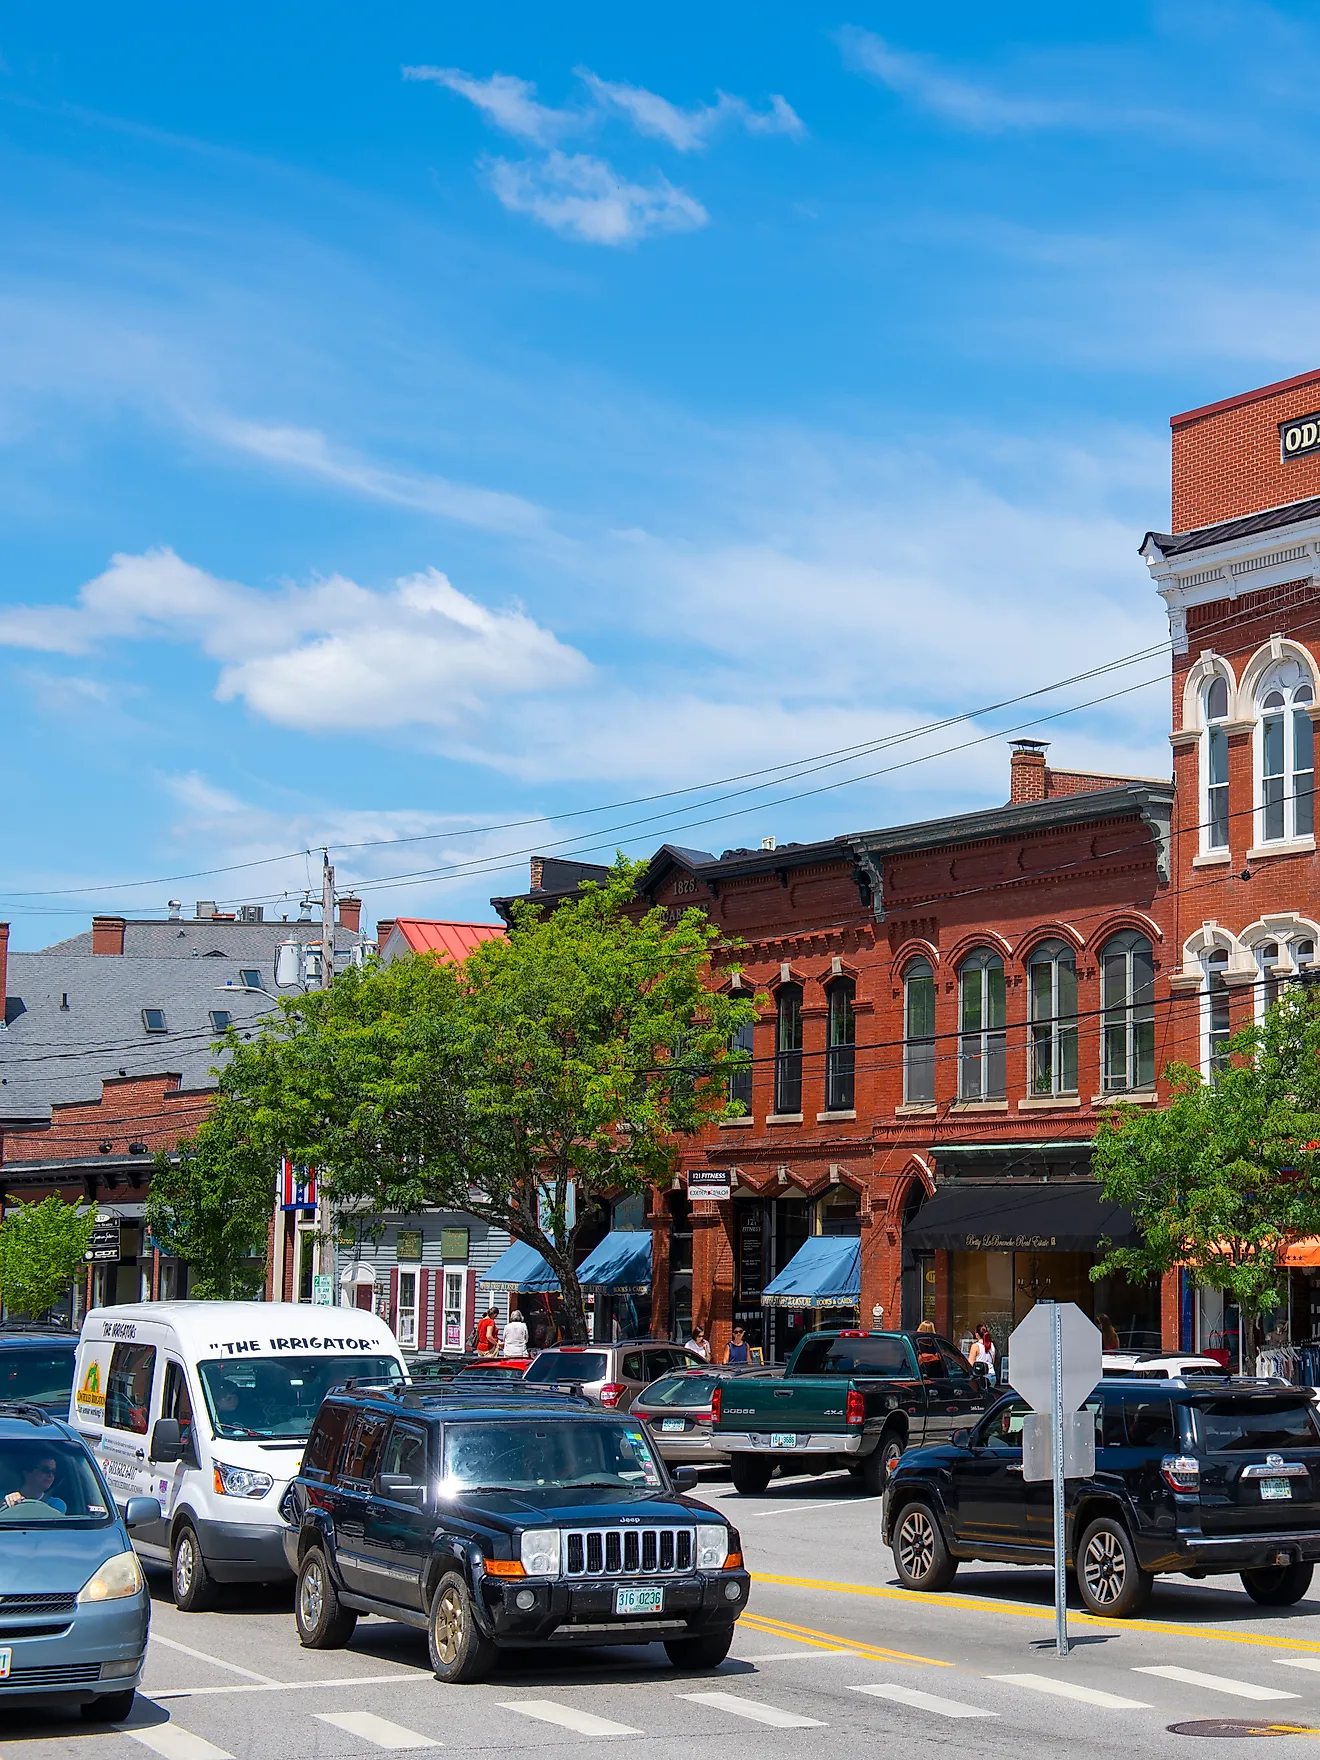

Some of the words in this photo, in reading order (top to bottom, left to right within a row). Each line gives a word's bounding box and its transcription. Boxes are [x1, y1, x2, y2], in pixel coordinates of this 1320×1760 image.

[1015, 1234, 1032, 1248] Real
[619, 1516, 641, 1524] Jeep
[618, 1592, 635, 1606] 316
[639, 1591, 661, 1606] 0236
